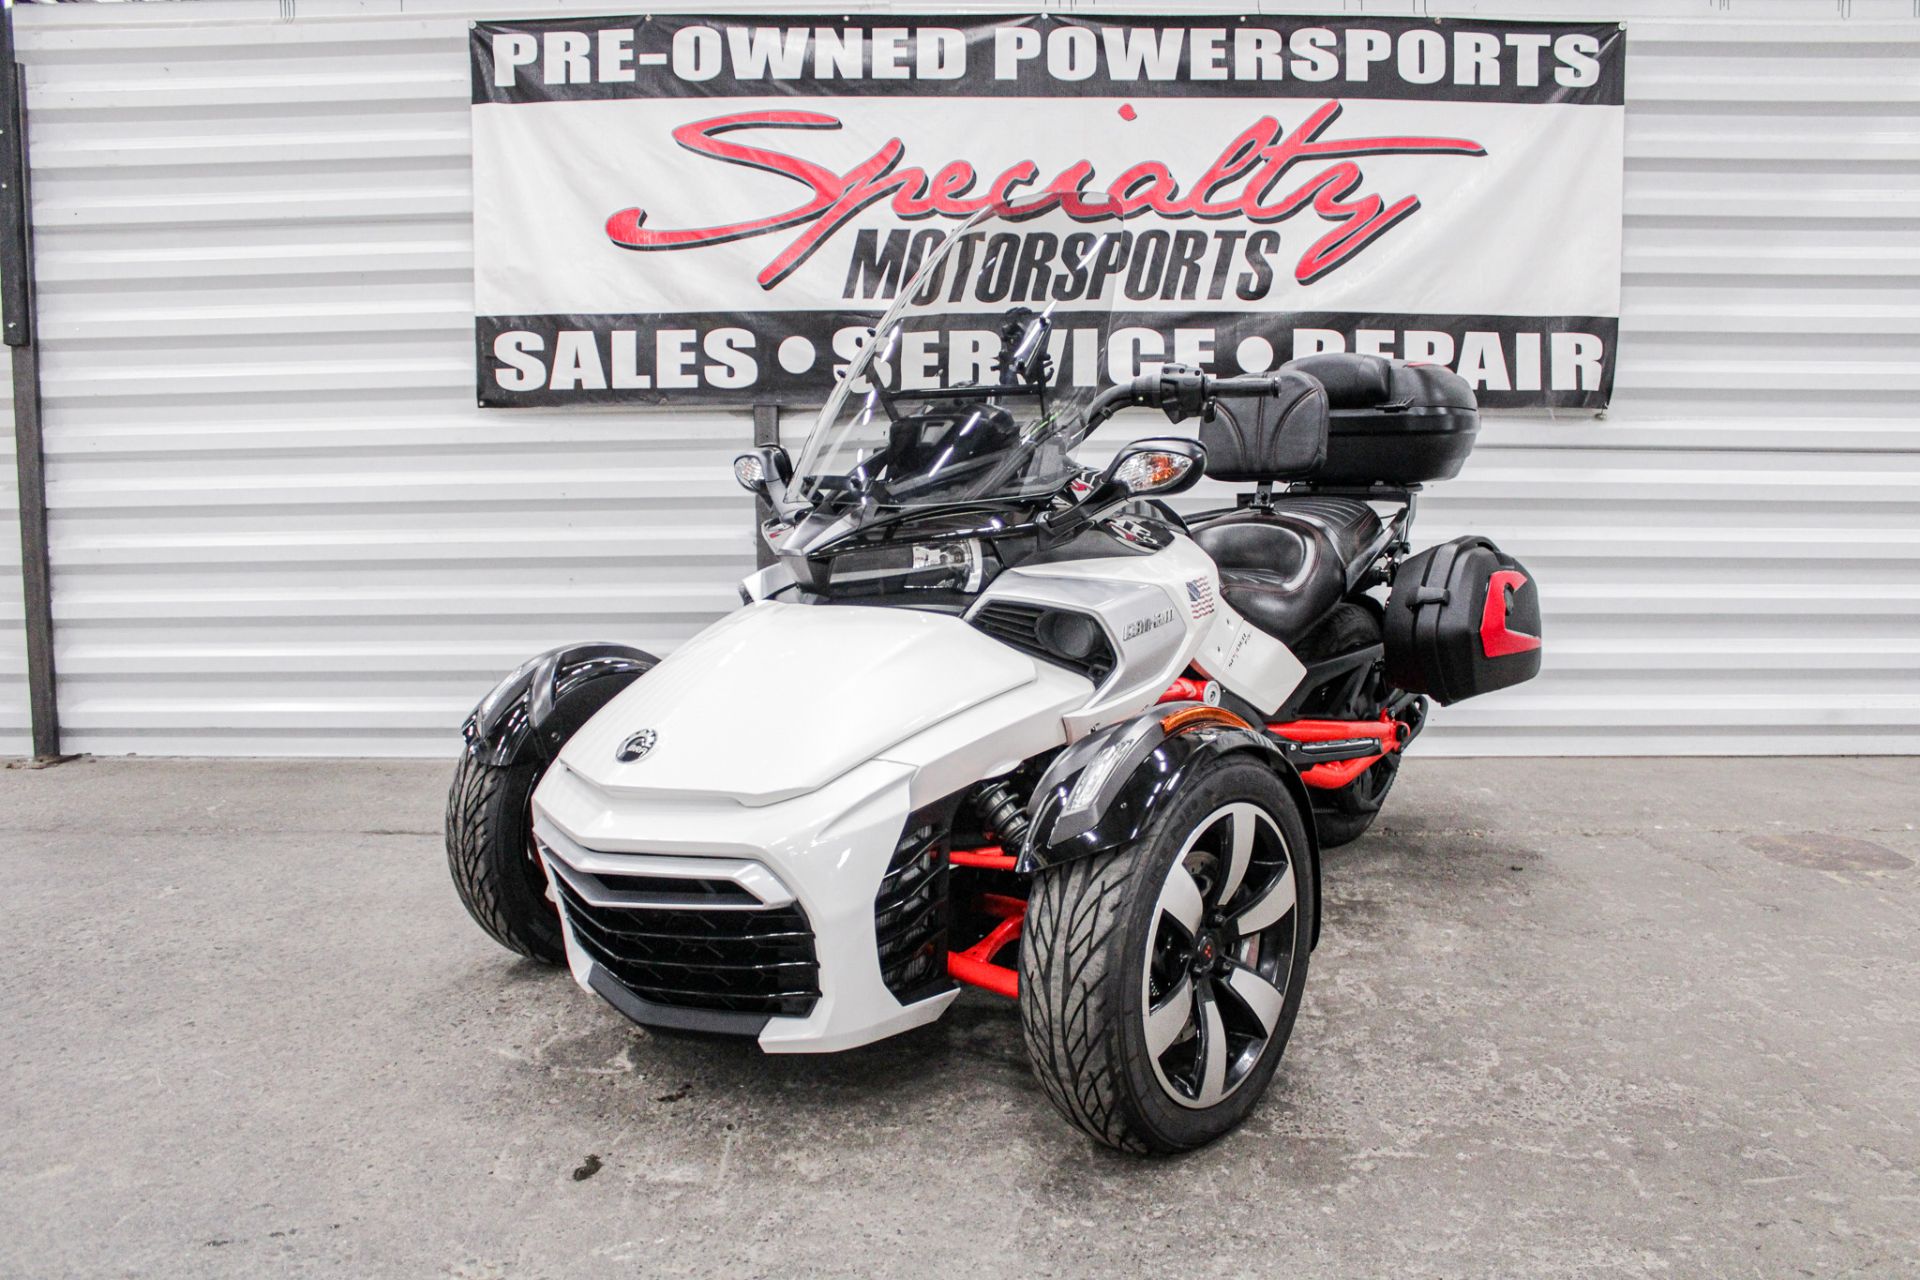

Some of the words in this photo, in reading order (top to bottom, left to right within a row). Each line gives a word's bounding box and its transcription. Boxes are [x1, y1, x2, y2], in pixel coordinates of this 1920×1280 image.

[492, 25, 967, 87] PRE-OWNED
[994, 26, 1601, 88] POWERSPORTS
[605, 99, 1488, 291] Specialty
[843, 228, 1281, 306] MOTORSPORTS
[493, 327, 759, 392] SALES
